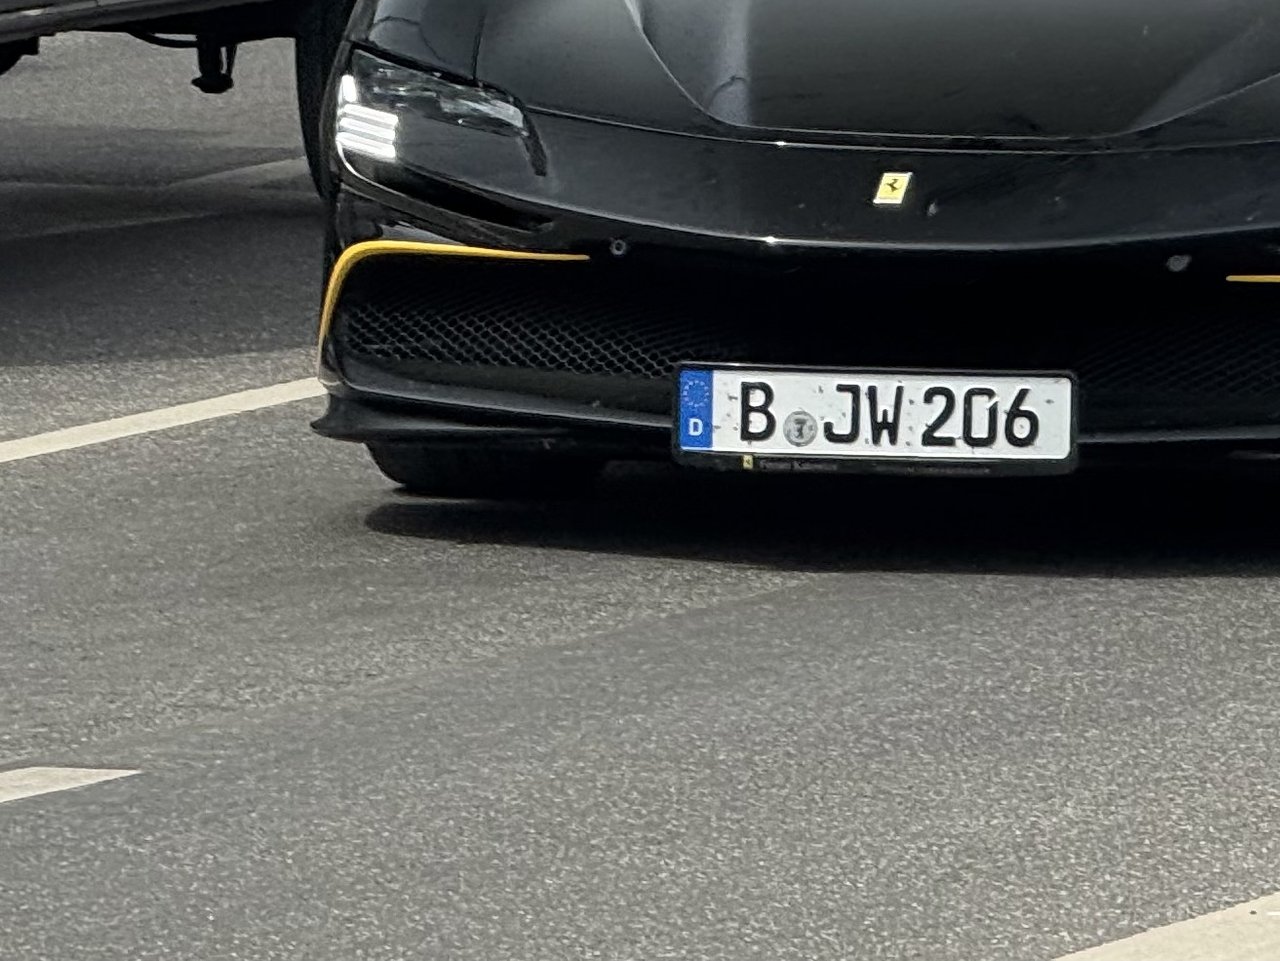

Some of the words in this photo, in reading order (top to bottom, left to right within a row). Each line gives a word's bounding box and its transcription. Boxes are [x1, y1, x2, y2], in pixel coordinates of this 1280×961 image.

[688, 418, 703, 437] D
[740, 381, 776, 442] B
[823, 384, 904, 446] JW
[921, 386, 1040, 448] 206
